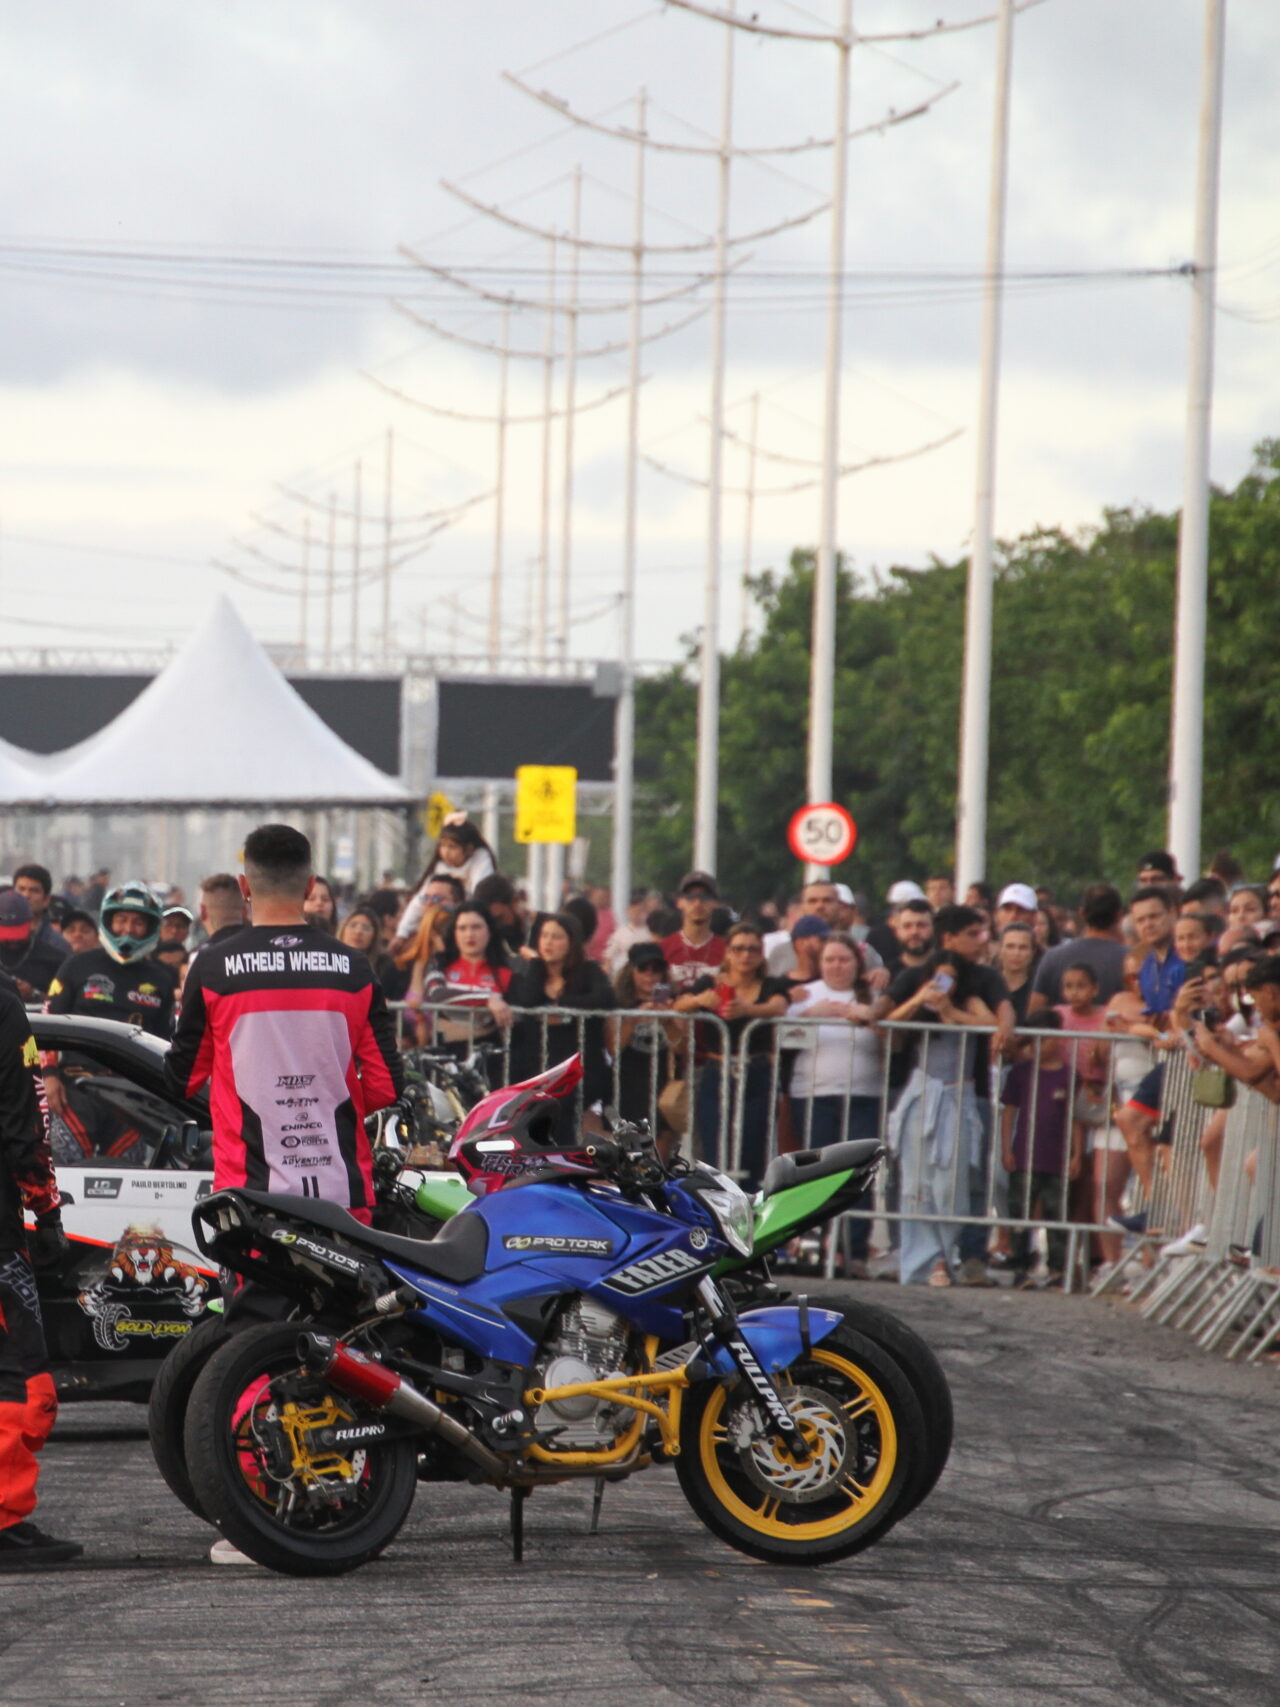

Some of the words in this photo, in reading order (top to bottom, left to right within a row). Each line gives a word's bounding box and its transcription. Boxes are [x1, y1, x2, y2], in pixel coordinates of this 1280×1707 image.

[806, 818, 843, 844] 50
[224, 951, 285, 977] MATHEUS
[289, 951, 350, 975] WHEELING
[131, 1180, 152, 1189] PAULO
[296, 1237, 327, 1255] PRO
[327, 1250, 365, 1272] TORK
[533, 1237, 566, 1247] PRO
[566, 1239, 608, 1250] TORK
[610, 1248, 703, 1290] FAZER
[728, 1342, 794, 1430] FULLPRO
[336, 1424, 386, 1441] FULLPRO
